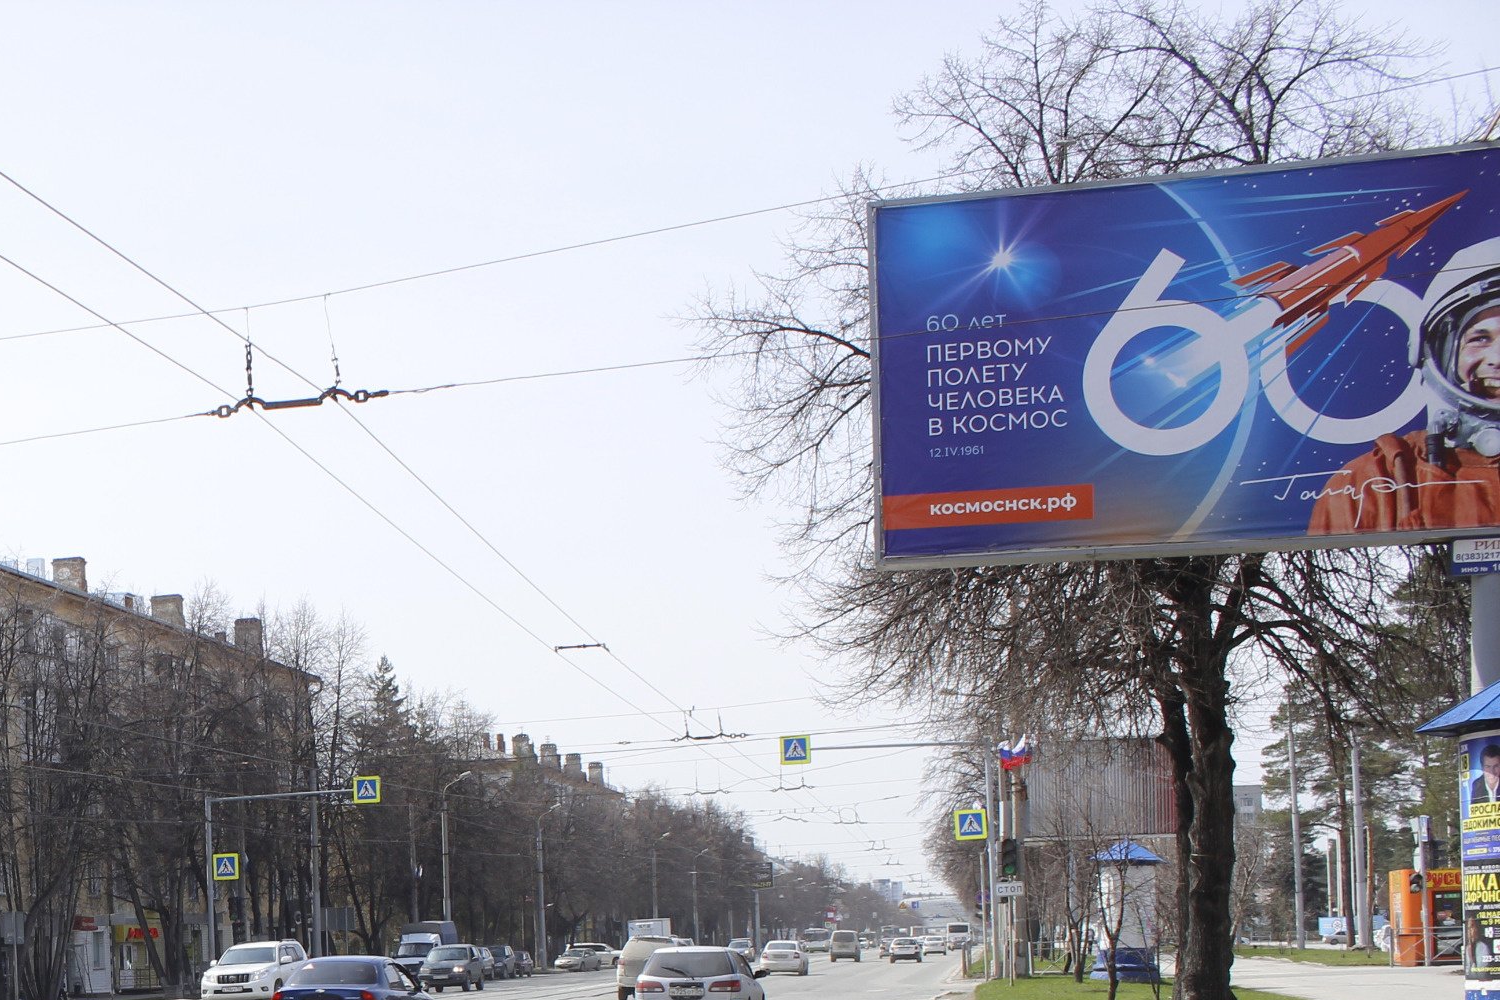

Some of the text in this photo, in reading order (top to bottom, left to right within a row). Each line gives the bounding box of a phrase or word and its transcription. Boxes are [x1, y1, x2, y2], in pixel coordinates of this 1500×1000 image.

[926, 313, 1007, 332] 60 лет
[926, 335, 1052, 363] ПЕРВОМУ
[927, 362, 1028, 388] ПОЛЕТУ
[928, 384, 1064, 411] ЧЕЛОВЕКА
[928, 408, 1068, 436] В КОСМОС
[929, 445, 984, 458] 12.IV.1961
[930, 492, 1077, 516] космоснск.рф
[1474, 540, 1500, 550] РИ
[998, 885, 1022, 894] СТОП
